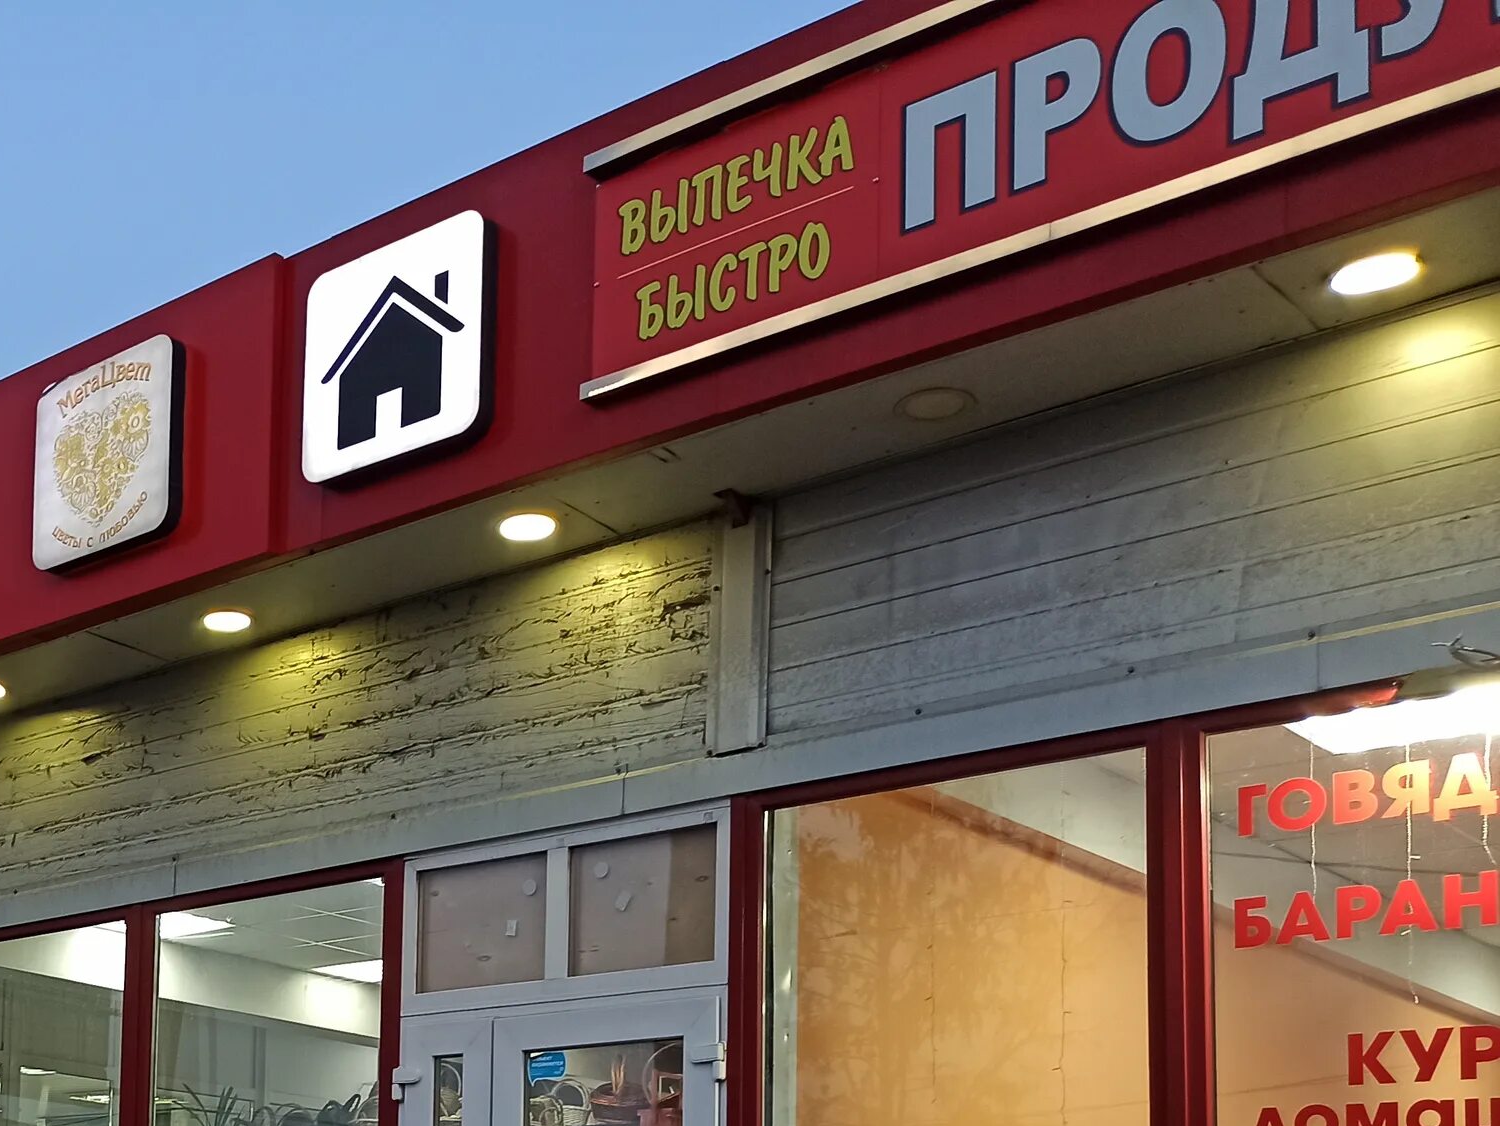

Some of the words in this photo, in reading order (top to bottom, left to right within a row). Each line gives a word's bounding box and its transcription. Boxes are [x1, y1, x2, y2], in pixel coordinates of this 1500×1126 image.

[900, 0, 1500, 232] ПРОД
[618, 115, 855, 256] ВЫПЕЧКА
[636, 220, 832, 342] БЫСТРО
[1236, 752, 1498, 838] ГОВЯД
[1234, 870, 1499, 949] БАРАН
[1347, 1025, 1500, 1086] КУР
